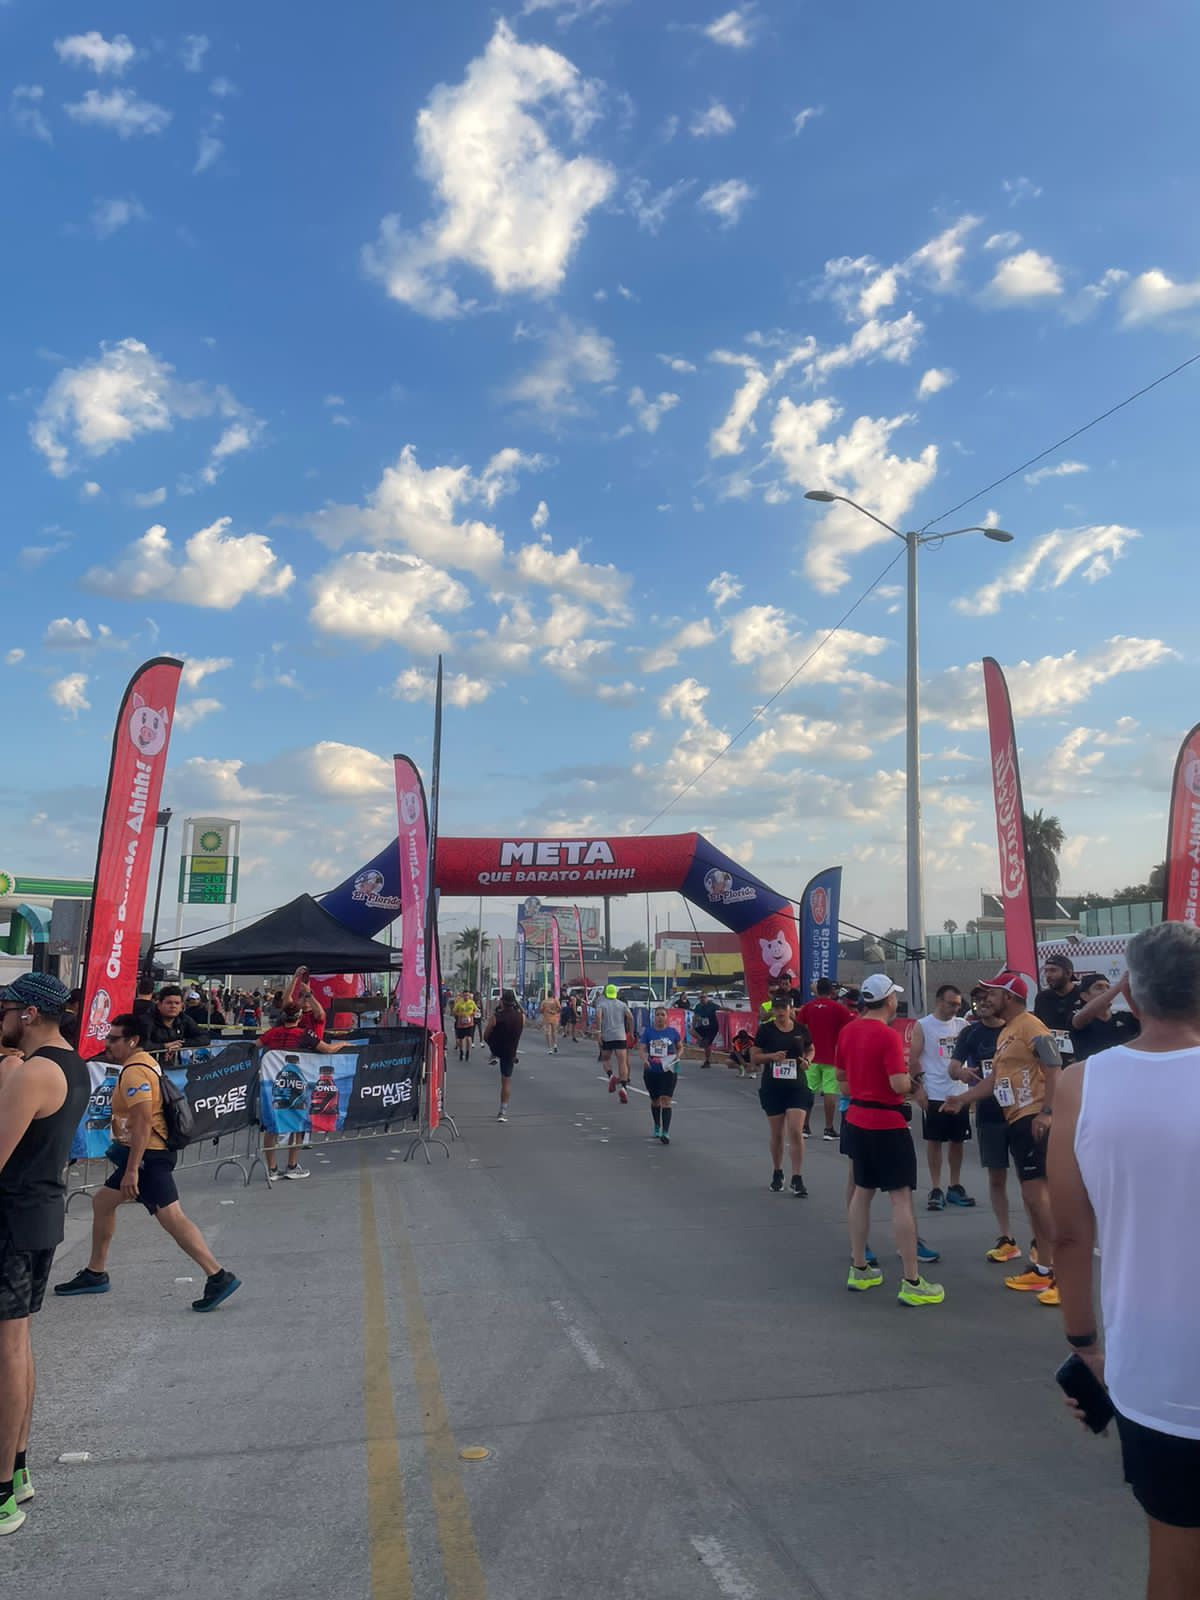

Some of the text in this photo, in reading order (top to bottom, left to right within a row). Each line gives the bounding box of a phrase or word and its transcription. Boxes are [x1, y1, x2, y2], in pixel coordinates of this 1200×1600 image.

[500, 841, 615, 866] META
[106, 929, 124, 980] Que
[126, 760, 153, 834] Ahhh!
[478, 867, 636, 885] QUE BARATO AHHH!
[821, 927, 831, 978] rmacia
[195, 1085, 247, 1113] POWER
[361, 1078, 412, 1099] POWER
[383, 1089, 411, 1107] ADE
